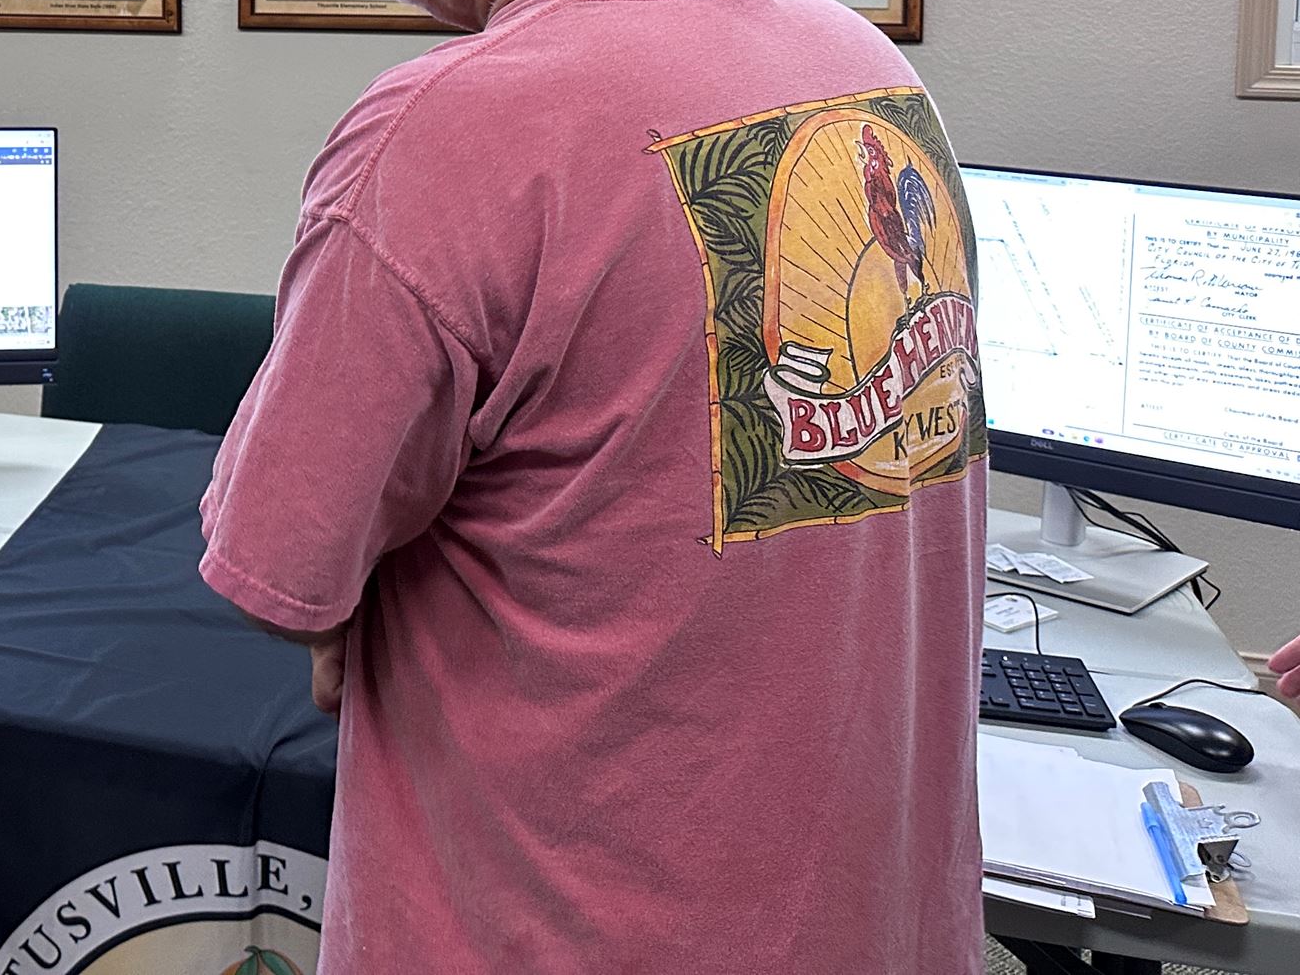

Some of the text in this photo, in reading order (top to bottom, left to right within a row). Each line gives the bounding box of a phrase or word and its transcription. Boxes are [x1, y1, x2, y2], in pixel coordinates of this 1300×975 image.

[1223, 233, 1290, 245] MUNICIPALITY
[1139, 316, 1290, 344] CERTIFICATE OF ACCEPTANCE OF
[1164, 332, 1197, 343] BOARD
[1201, 337, 1212, 346] OF
[1218, 339, 1256, 352] COUNTY
[1193, 350, 1222, 358] CERTIFY
[1254, 358, 1273, 366] Board
[787, 365, 903, 453] BLUE
[894, 298, 978, 393] HEAVEN
[1278, 415, 1299, 424] Board
[893, 413, 914, 461] KY
[1031, 438, 1053, 450] DELL
[1263, 438, 1284, 447] Board
[1222, 441, 1234, 450] OF
[1238, 444, 1290, 460] APPROVAL
